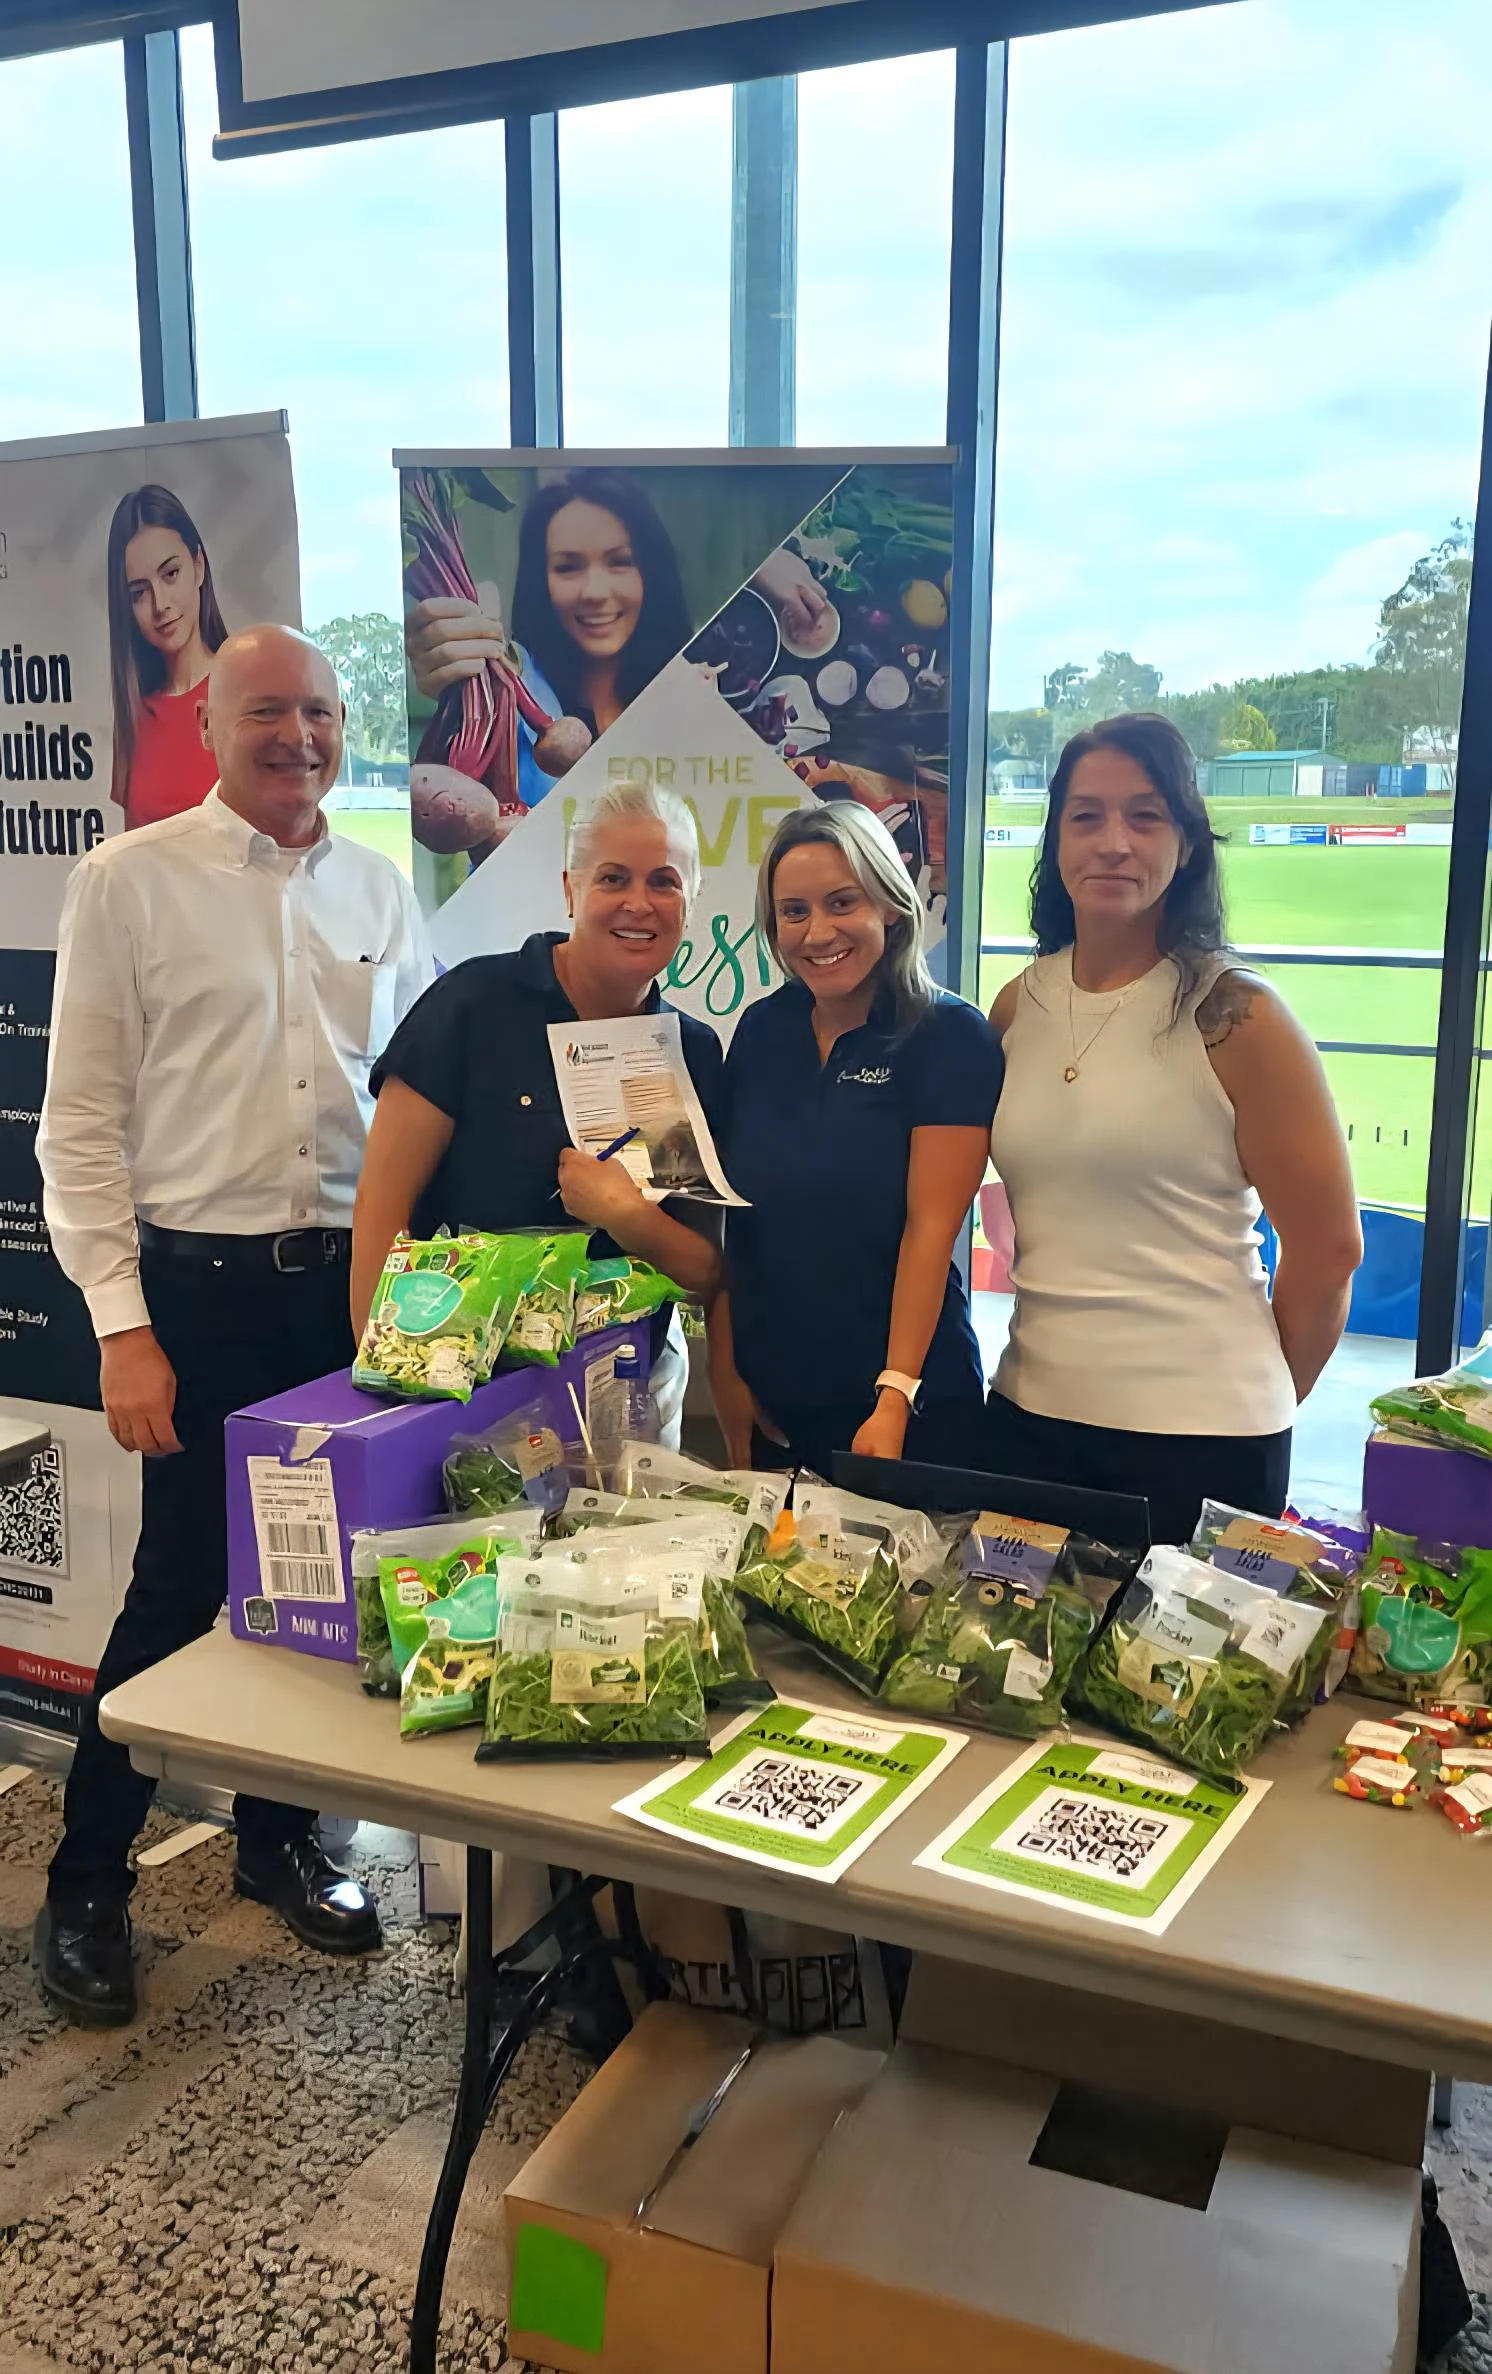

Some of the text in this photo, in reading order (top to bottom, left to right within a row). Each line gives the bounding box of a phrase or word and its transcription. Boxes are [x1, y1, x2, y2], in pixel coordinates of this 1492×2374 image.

[0, 720, 94, 781] uilds
[684, 755, 755, 785] THE
[746, 1728, 838, 1755] APPLY
[841, 1748, 920, 1776] HERE
[1034, 1765, 1134, 1794] APPLY
[1141, 1789, 1225, 1819] HERE
